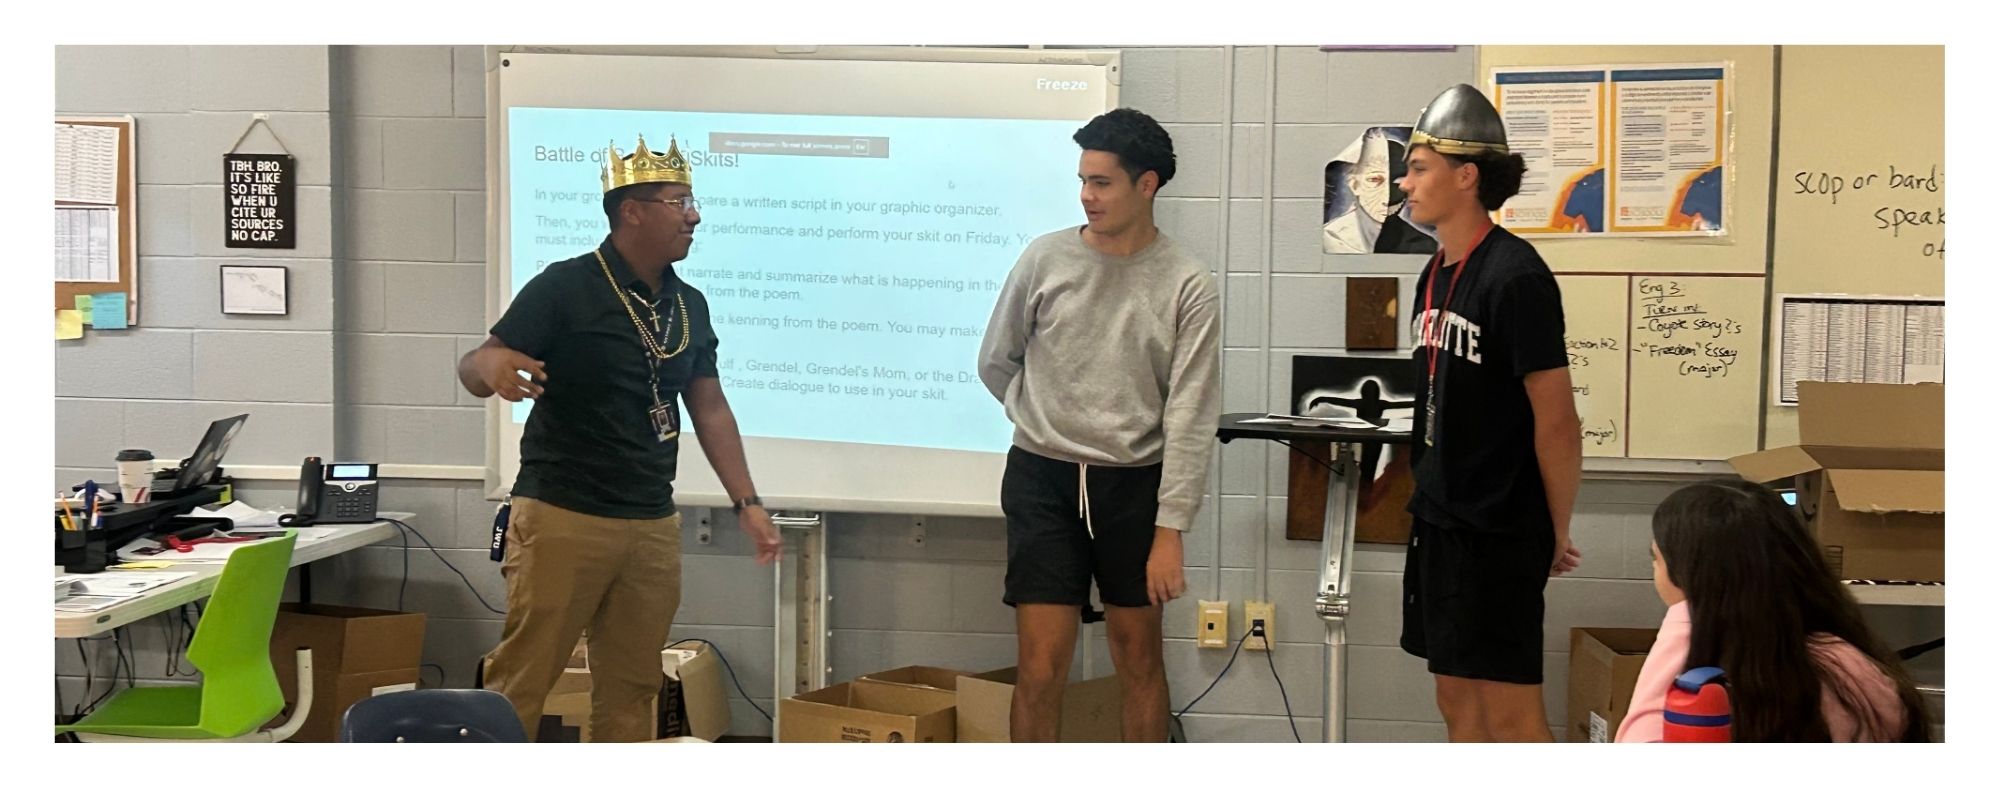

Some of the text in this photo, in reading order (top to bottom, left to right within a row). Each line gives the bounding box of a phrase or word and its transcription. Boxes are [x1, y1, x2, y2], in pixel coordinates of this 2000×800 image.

[1037, 78, 1088, 90] Freeze
[535, 145, 585, 162] Battle
[591, 147, 608, 163] of
[690, 150, 739, 168] Skits!
[256, 160, 283, 172] BRO.
[230, 172, 281, 183] IT'S LIKE
[1853, 173, 1878, 190] or
[230, 184, 277, 195] SO FIRE
[535, 189, 603, 204] In your gro
[230, 195, 278, 207] WHEN U
[731, 198, 740, 208] a
[743, 197, 787, 209] written
[790, 199, 828, 213] script
[830, 199, 843, 211] in
[846, 201, 877, 214] your
[880, 201, 931, 216] graphic
[934, 203, 1002, 217] organizer.
[231, 207, 276, 218] CITE UR
[231, 218, 284, 230] SOURCES
[535, 215, 571, 230] Then,
[575, 218, 599, 231] you
[231, 230, 279, 242] NO CAP.
[535, 235, 600, 247] must inclu
[711, 222, 794, 236] performance
[798, 225, 824, 238] and
[827, 226, 879, 241] perform
[883, 229, 913, 243] your
[917, 230, 940, 243] skit
[944, 232, 961, 244] on
[965, 231, 1012, 248] Friday.
[687, 267, 733, 280] narrate
[737, 269, 762, 281] and
[765, 272, 838, 285] summarize
[841, 273, 874, 286] what
[877, 274, 889, 287] is
[892, 274, 964, 293] happening
[968, 279, 980, 291] in
[706, 284, 804, 302] from the poem.
[1639, 278, 1664, 303] Eng
[728, 314, 779, 330] kenning
[783, 315, 813, 329] from
[817, 317, 838, 330] the
[841, 320, 882, 334] poem.
[887, 320, 913, 334] You
[917, 325, 946, 339] may
[746, 359, 801, 375] Grendel,
[806, 362, 869, 377] Grendel's
[873, 366, 911, 382] Mom,
[914, 371, 928, 382] or
[932, 370, 954, 383] the
[958, 371, 981, 385] Dra
[722, 375, 948, 401] Create dialogue to use in your skit.
